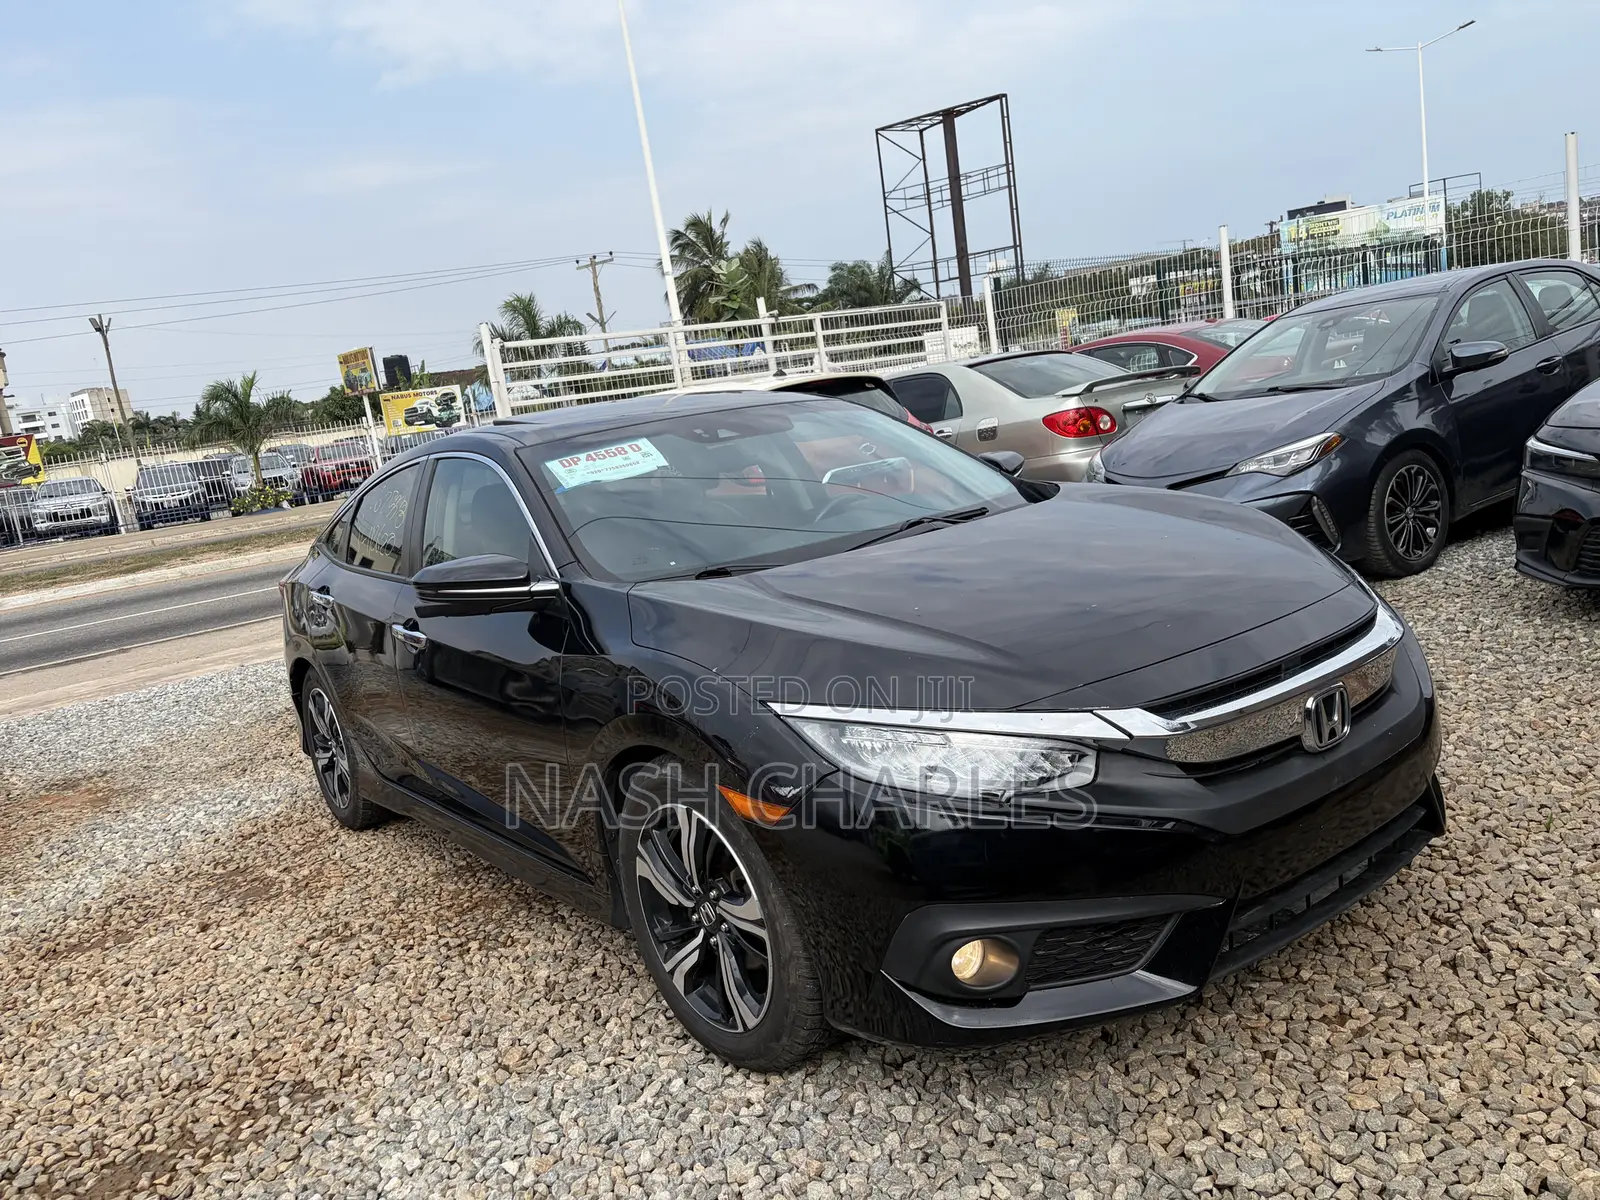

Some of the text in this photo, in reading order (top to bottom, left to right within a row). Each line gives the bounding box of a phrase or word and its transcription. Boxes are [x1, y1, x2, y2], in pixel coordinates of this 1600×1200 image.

[1415, 212, 1438, 222] GOD
[413, 390, 437, 398] MOTORS
[585, 446, 628, 462] 4558
[628, 443, 642, 453] D
